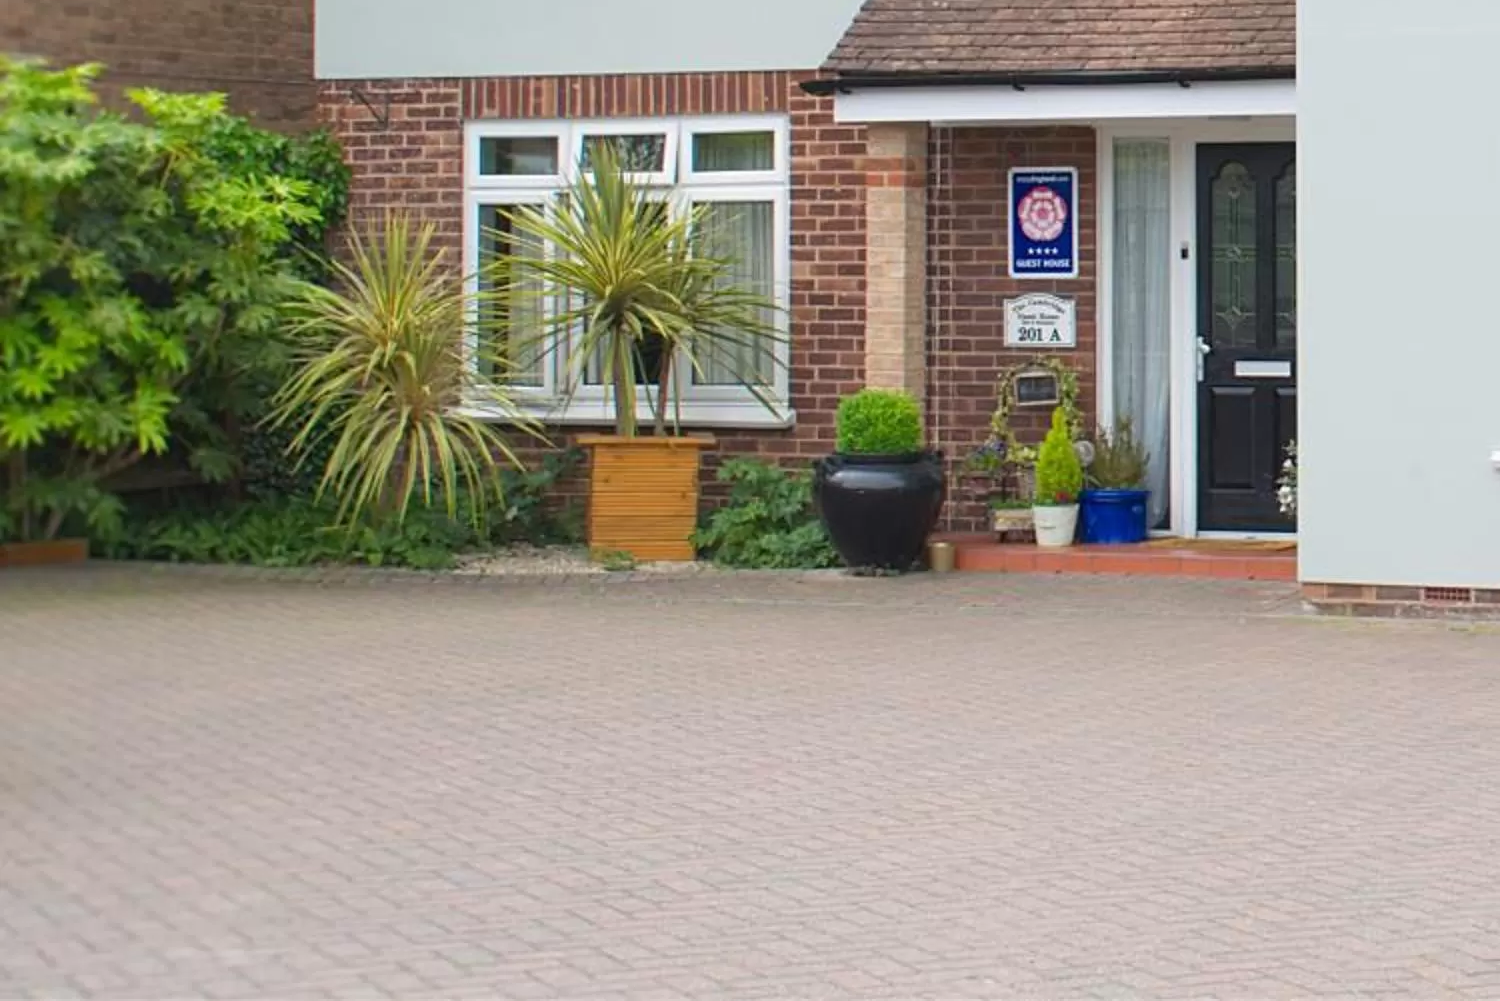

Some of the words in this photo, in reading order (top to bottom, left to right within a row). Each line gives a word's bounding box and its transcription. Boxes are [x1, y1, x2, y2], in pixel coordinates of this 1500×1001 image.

[1016, 259, 1041, 268] GUEST
[1043, 259, 1070, 268] HOUSE
[1018, 327, 1043, 342] 201
[1050, 328, 1062, 342] A
